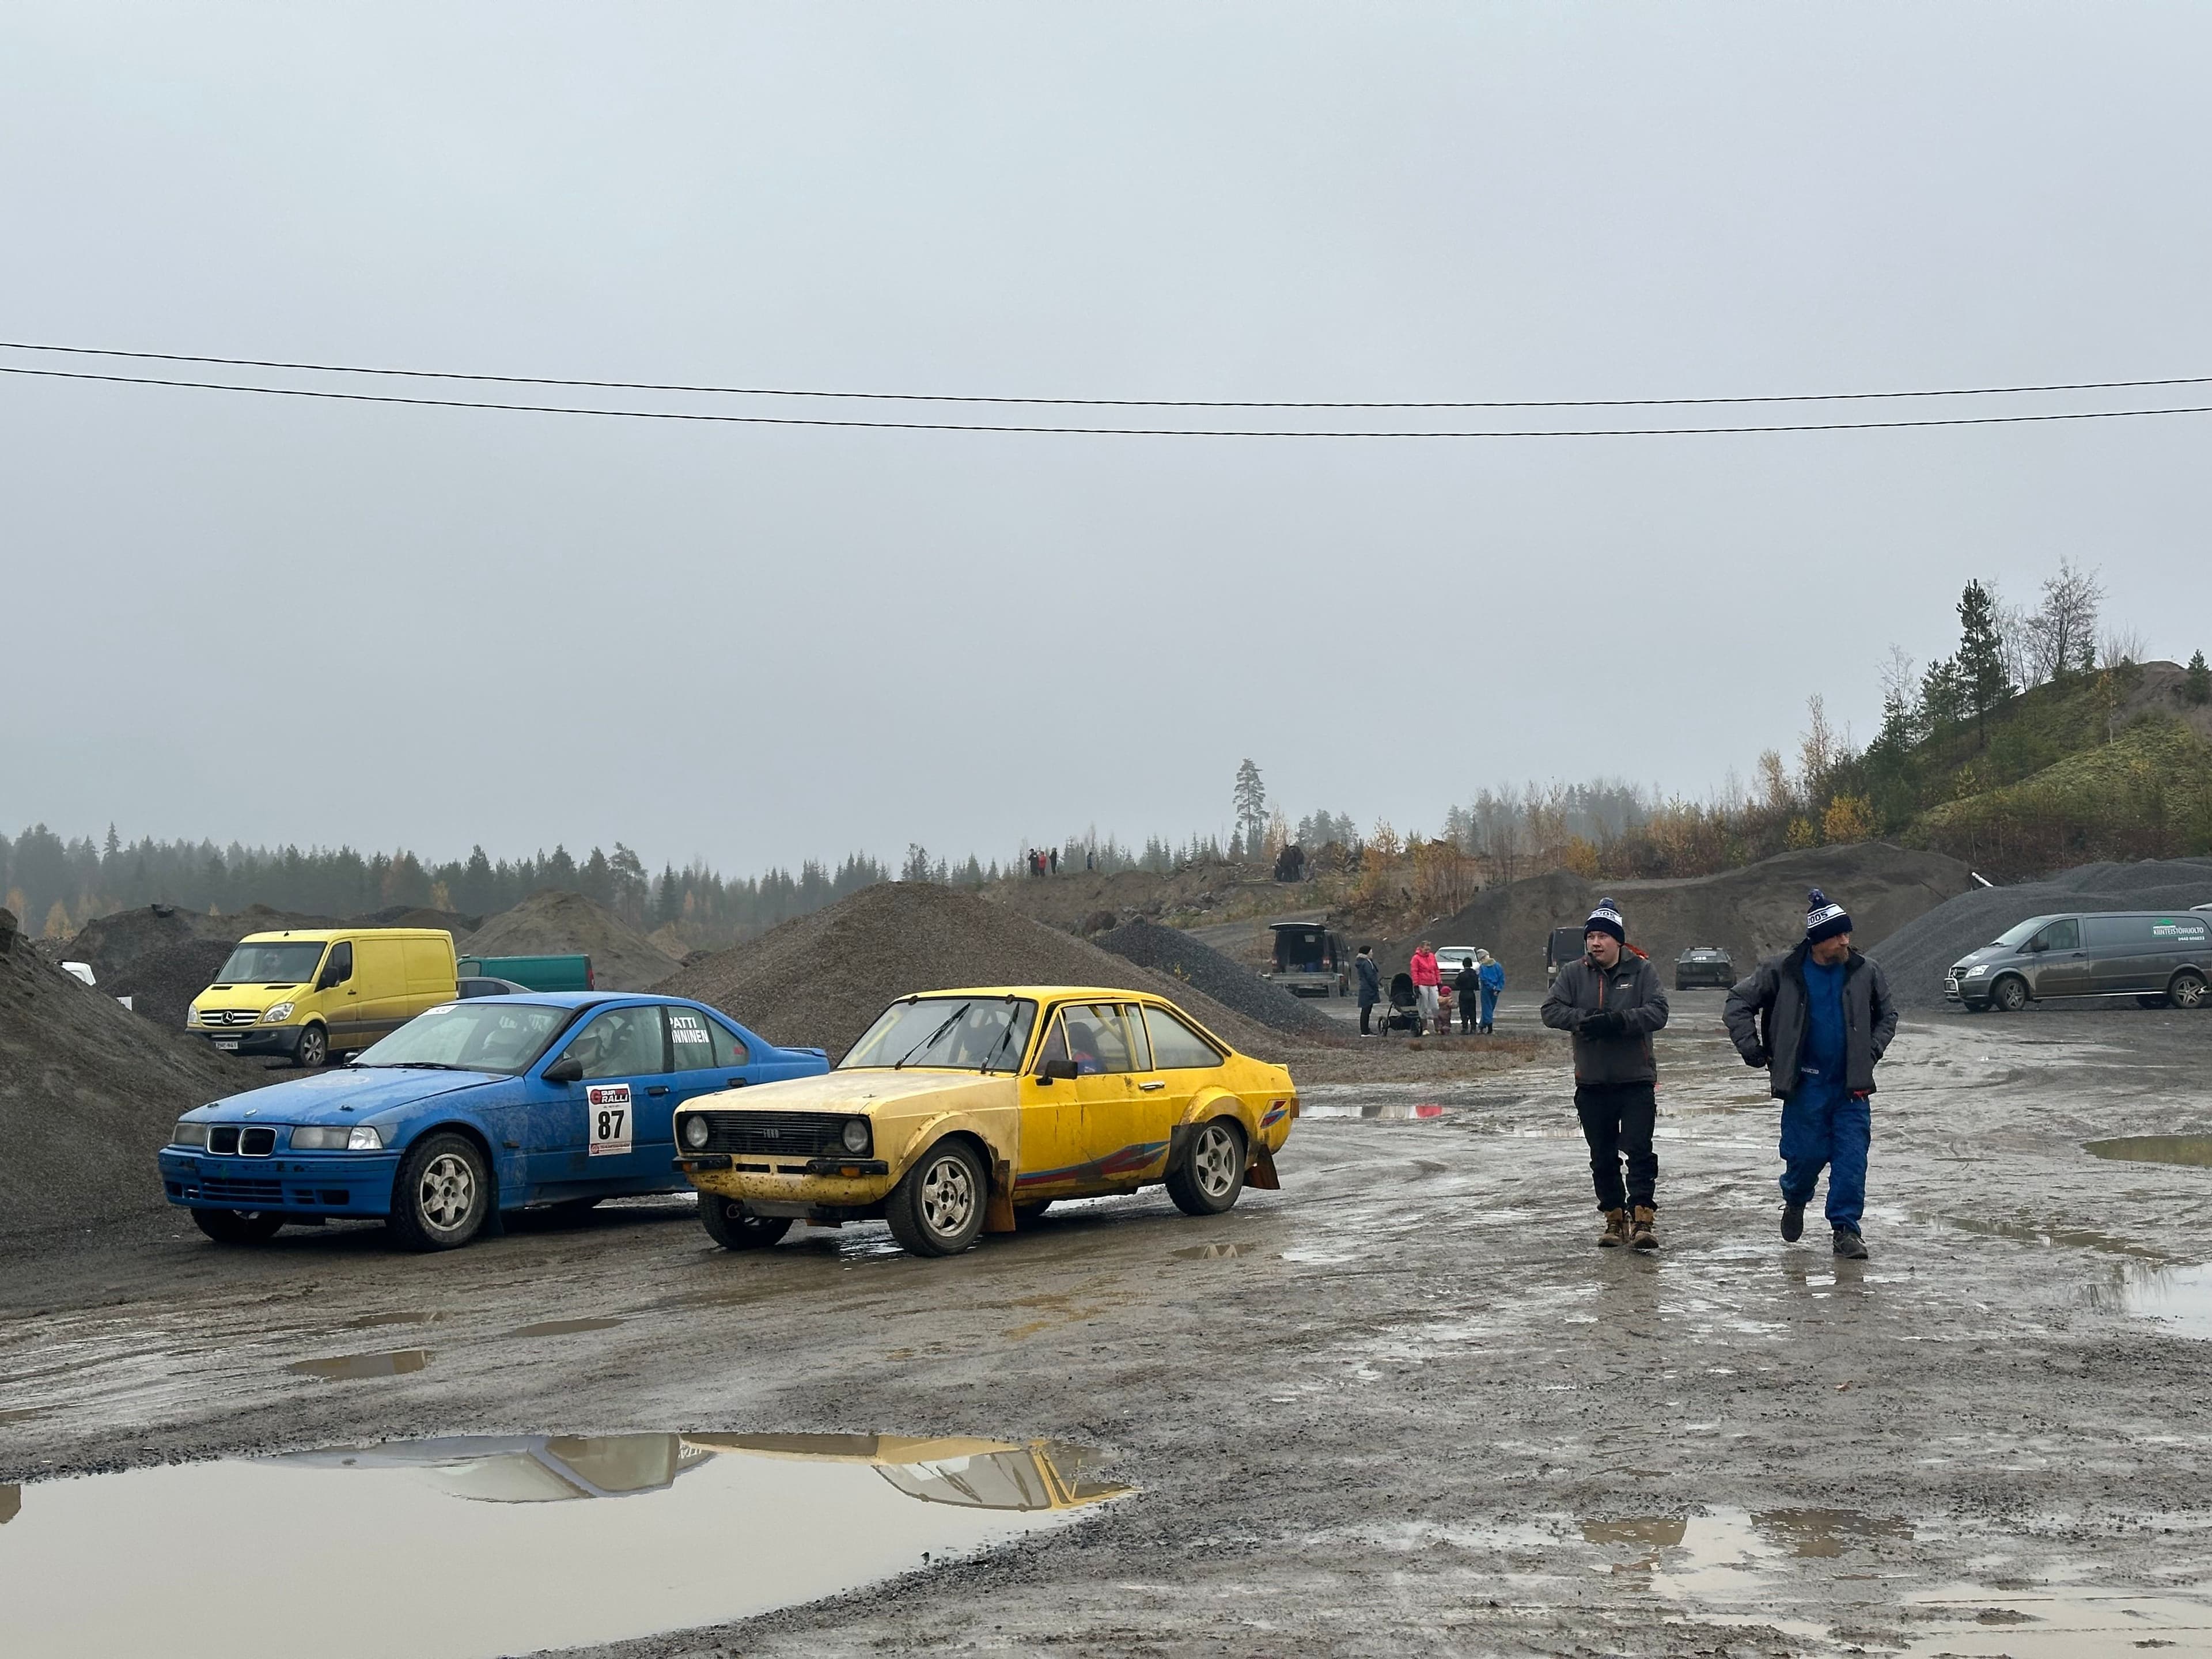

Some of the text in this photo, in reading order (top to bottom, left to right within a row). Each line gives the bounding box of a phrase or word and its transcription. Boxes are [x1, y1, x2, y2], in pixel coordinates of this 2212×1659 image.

[1808, 911, 1828, 924] 005
[601, 1094, 628, 1103] RALLI
[598, 1109, 624, 1140] 87
